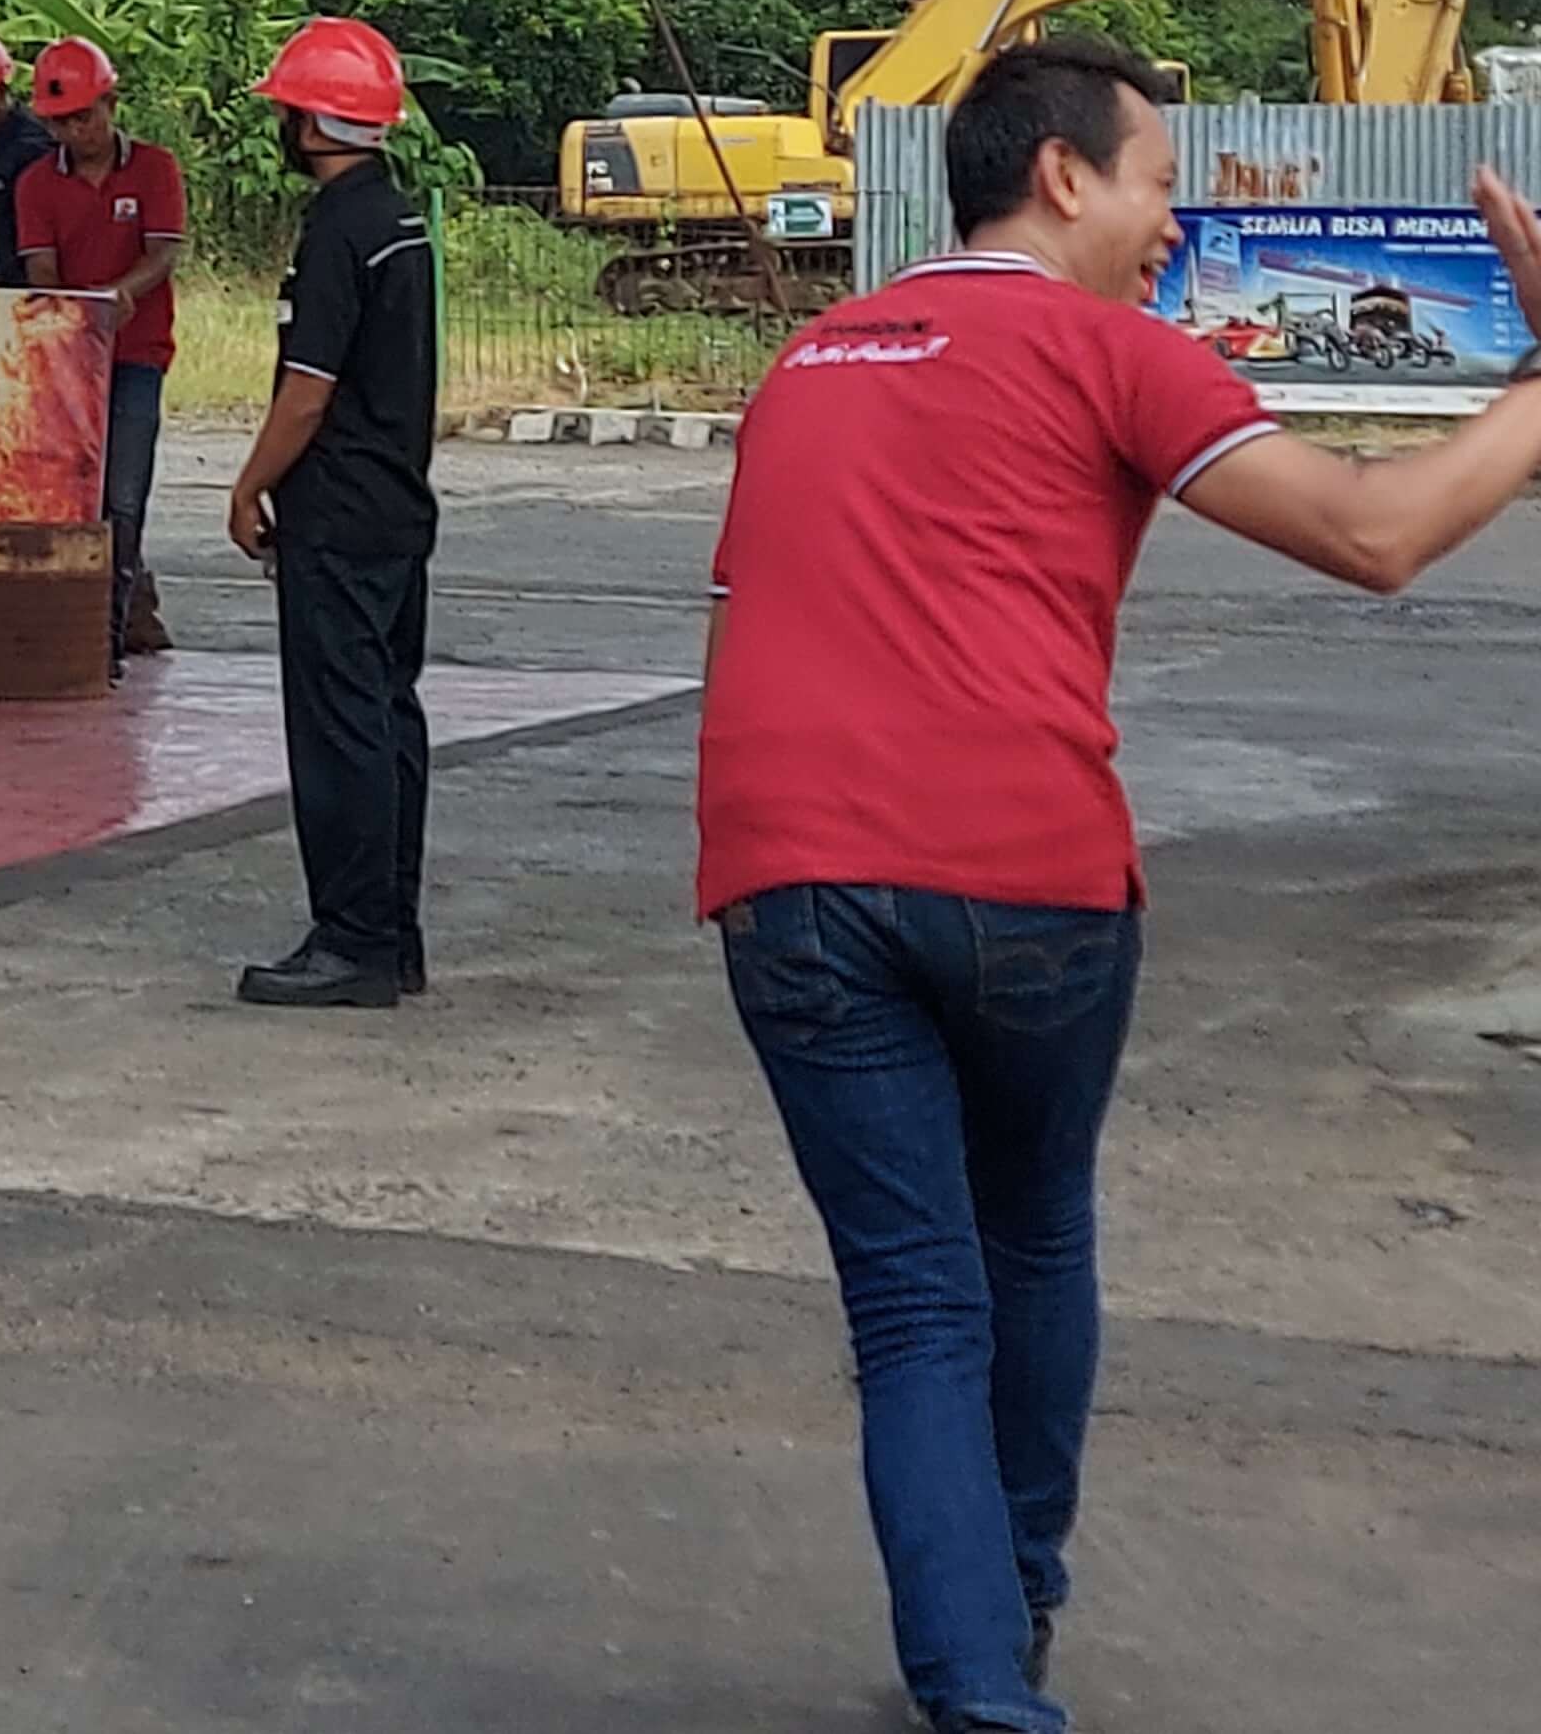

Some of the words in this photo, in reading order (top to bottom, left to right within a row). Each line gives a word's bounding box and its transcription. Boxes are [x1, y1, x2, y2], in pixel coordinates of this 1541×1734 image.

[1240, 215, 1321, 238] SEMUA
[1332, 218, 1385, 238] BISA
[1393, 217, 1488, 238] MENAN
